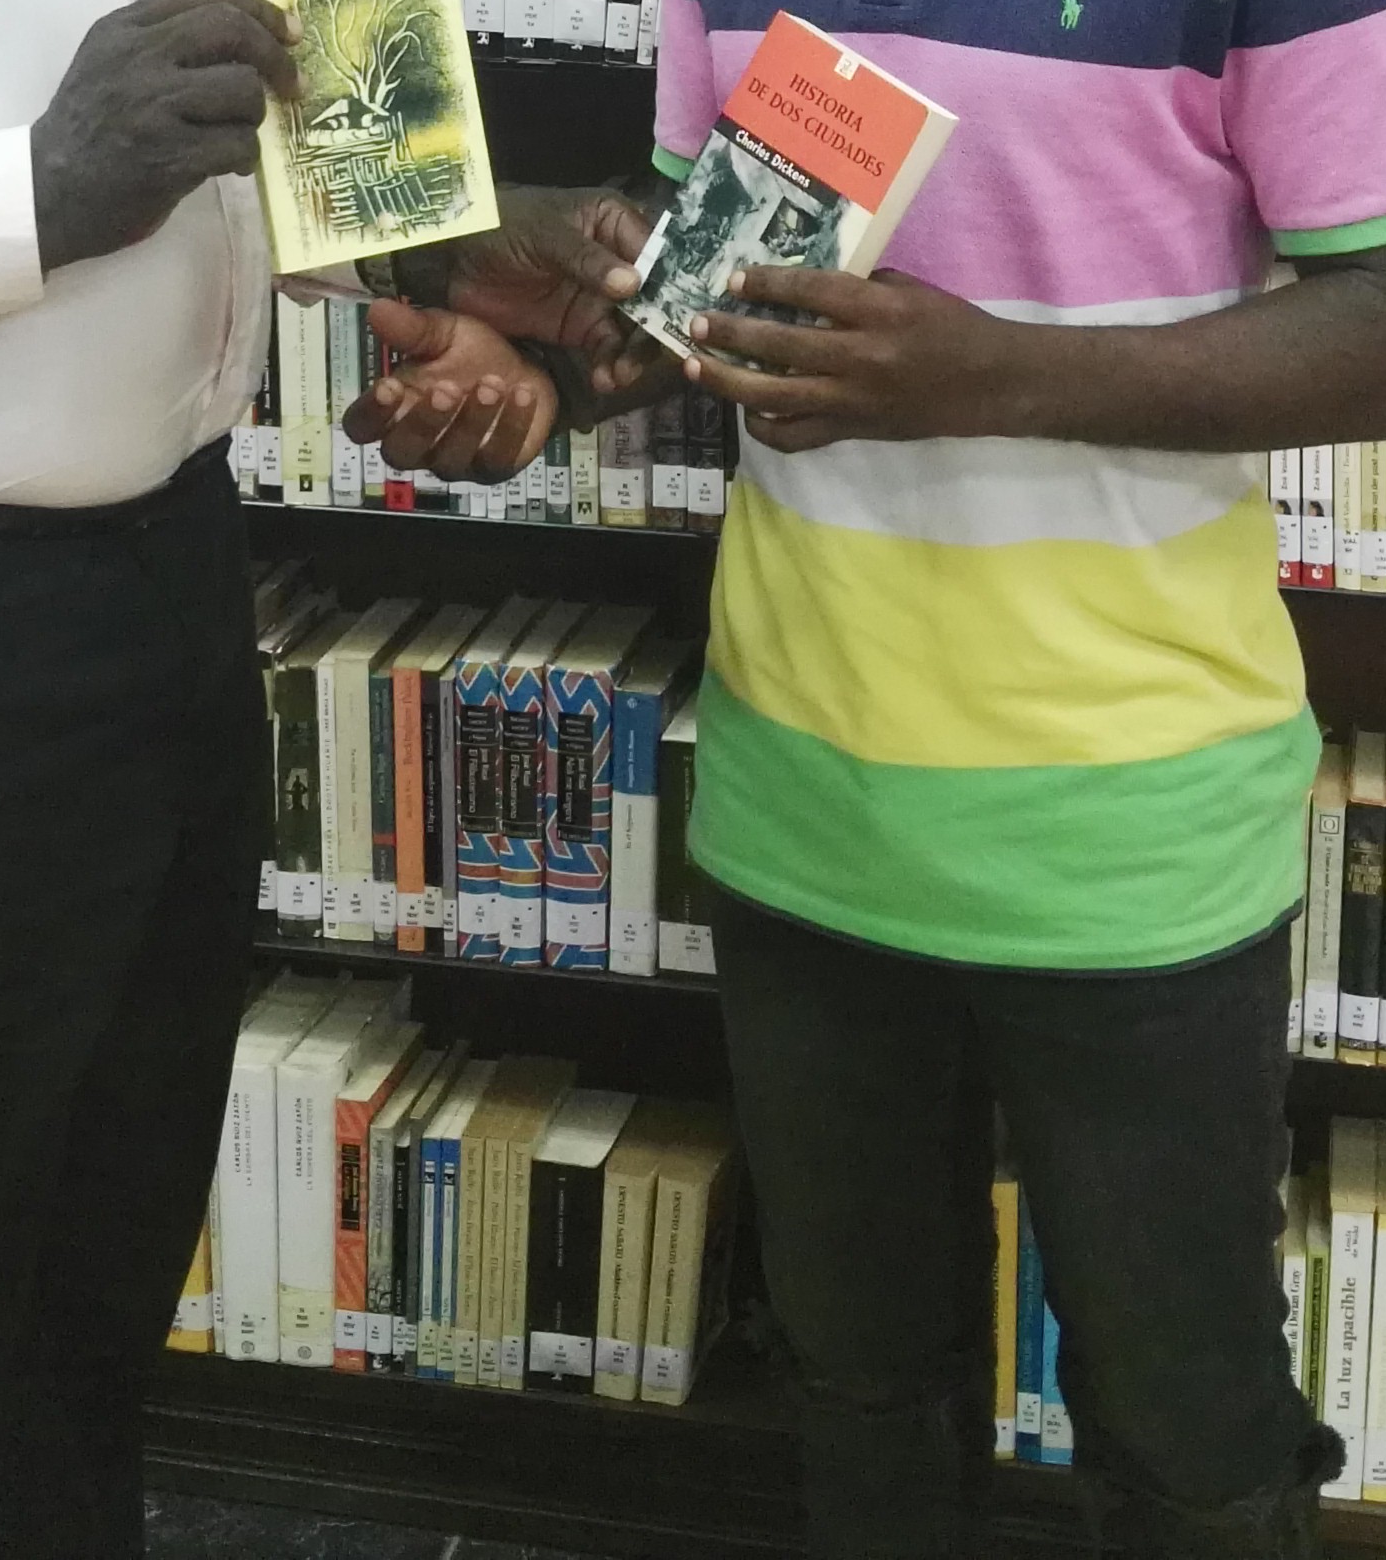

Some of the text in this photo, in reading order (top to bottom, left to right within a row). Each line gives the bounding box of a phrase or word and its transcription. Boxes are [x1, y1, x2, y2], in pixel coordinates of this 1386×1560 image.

[747, 77, 886, 178] DE DOS CIUDADES
[789, 73, 863, 133] HISTORIA
[735, 129, 811, 190] Charles Dickens
[1336, 1277, 1357, 1410] La luz apacible
